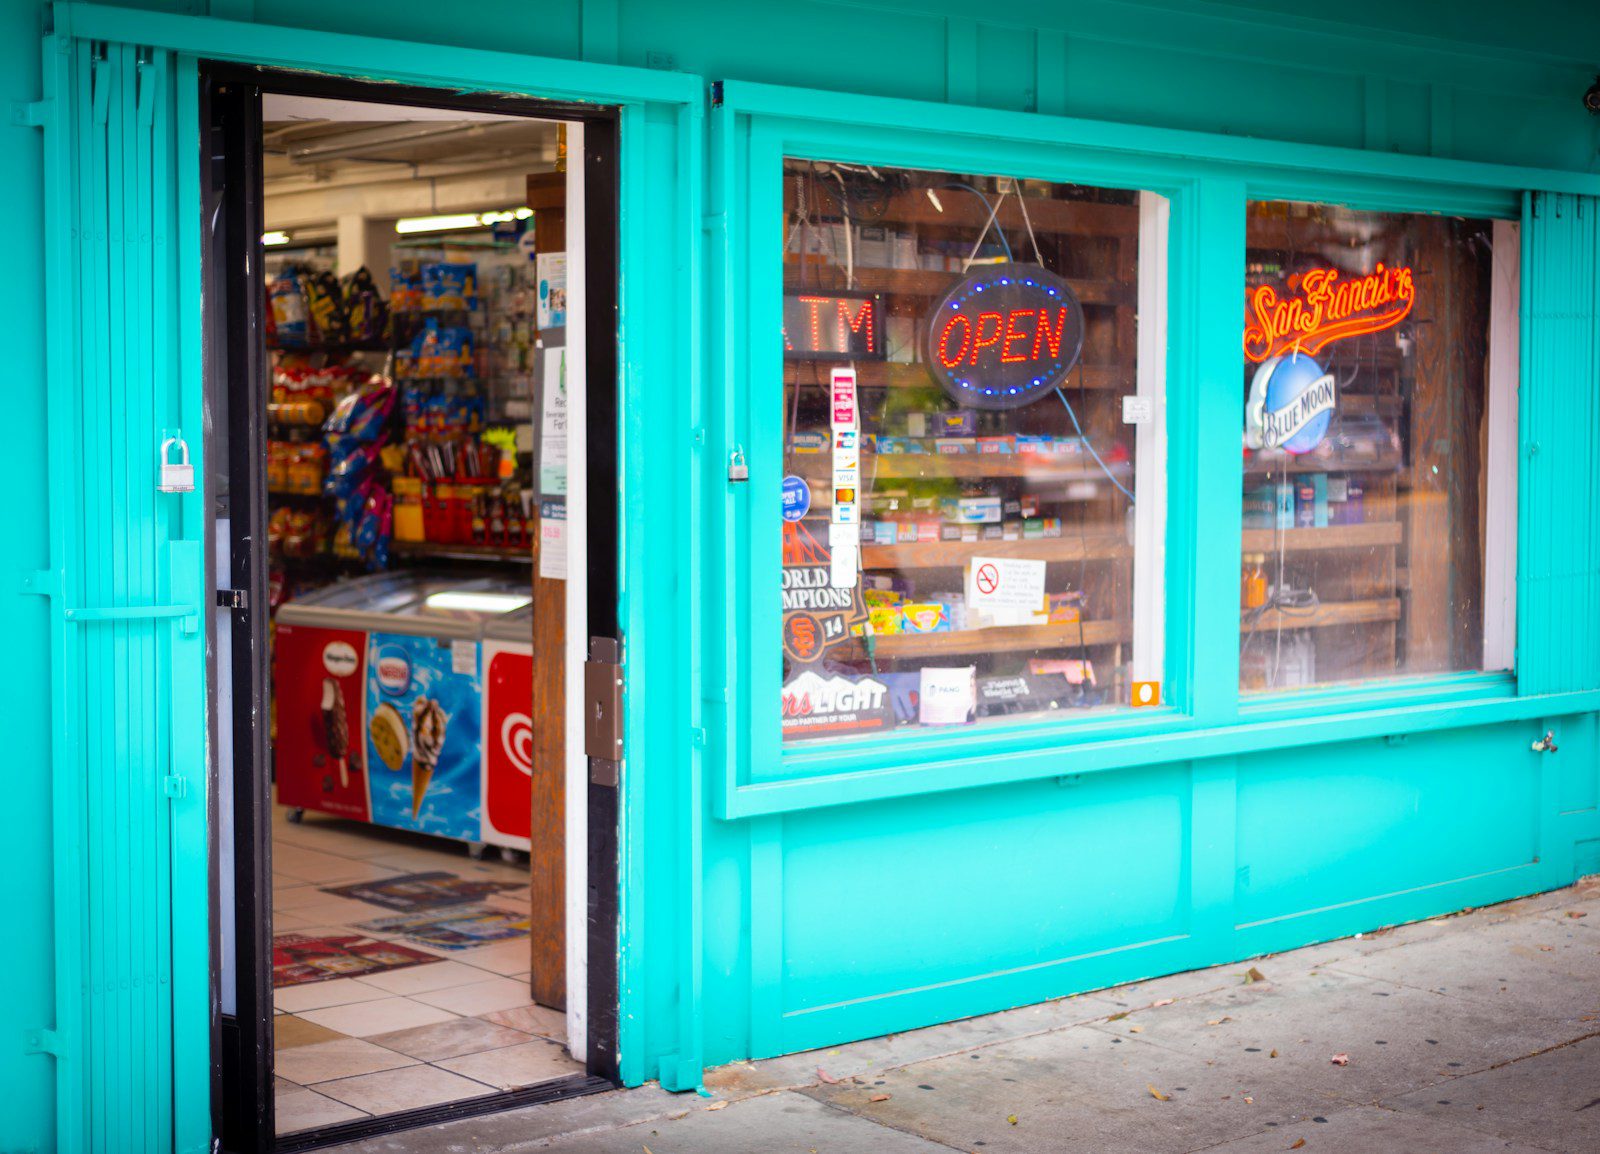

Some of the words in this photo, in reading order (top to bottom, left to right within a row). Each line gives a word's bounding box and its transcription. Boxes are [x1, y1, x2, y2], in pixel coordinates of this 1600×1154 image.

[782, 296, 874, 353] TM
[938, 306, 1069, 368] OPEN
[1243, 284, 1301, 363] San
[1261, 405, 1299, 449] BLUE
[1301, 381, 1334, 421] MOON
[825, 615, 842, 638] 14
[812, 683, 887, 713] LIGHT
[839, 714, 857, 722] YOUR
